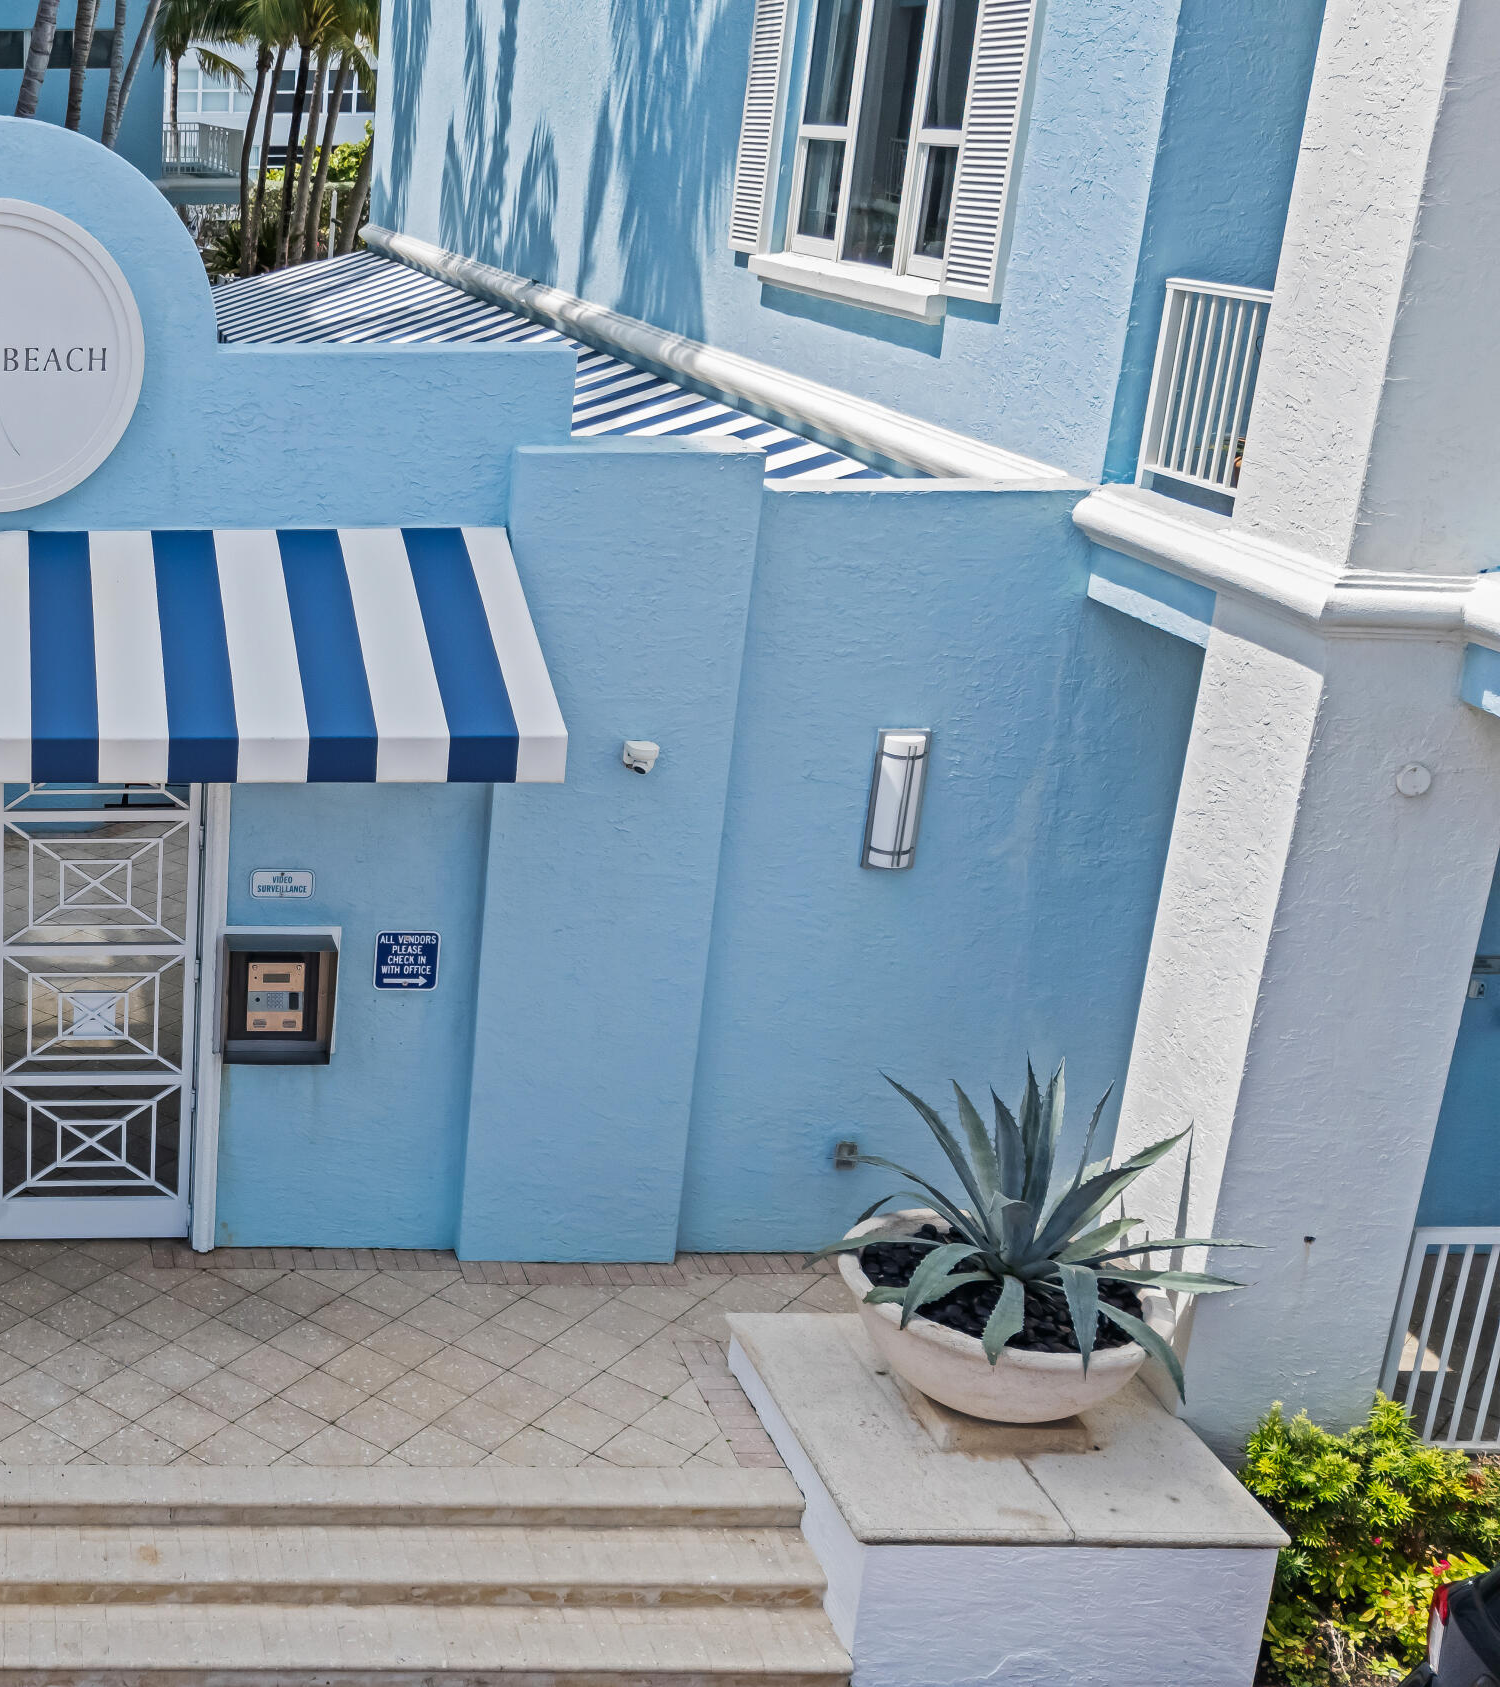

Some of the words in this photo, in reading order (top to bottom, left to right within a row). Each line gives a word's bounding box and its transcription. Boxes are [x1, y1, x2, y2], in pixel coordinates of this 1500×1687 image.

[3, 346, 108, 372] BEACH
[272, 875, 293, 884] VIDEO
[257, 884, 308, 893] SURVEILLANCE
[380, 935, 395, 944] ALL
[398, 935, 437, 944] VENDORS
[391, 945, 423, 954] PLEASE
[387, 955, 415, 964] CHECK
[417, 955, 427, 964] IN
[381, 965, 400, 974] WITH
[403, 965, 432, 975] OFFICE
